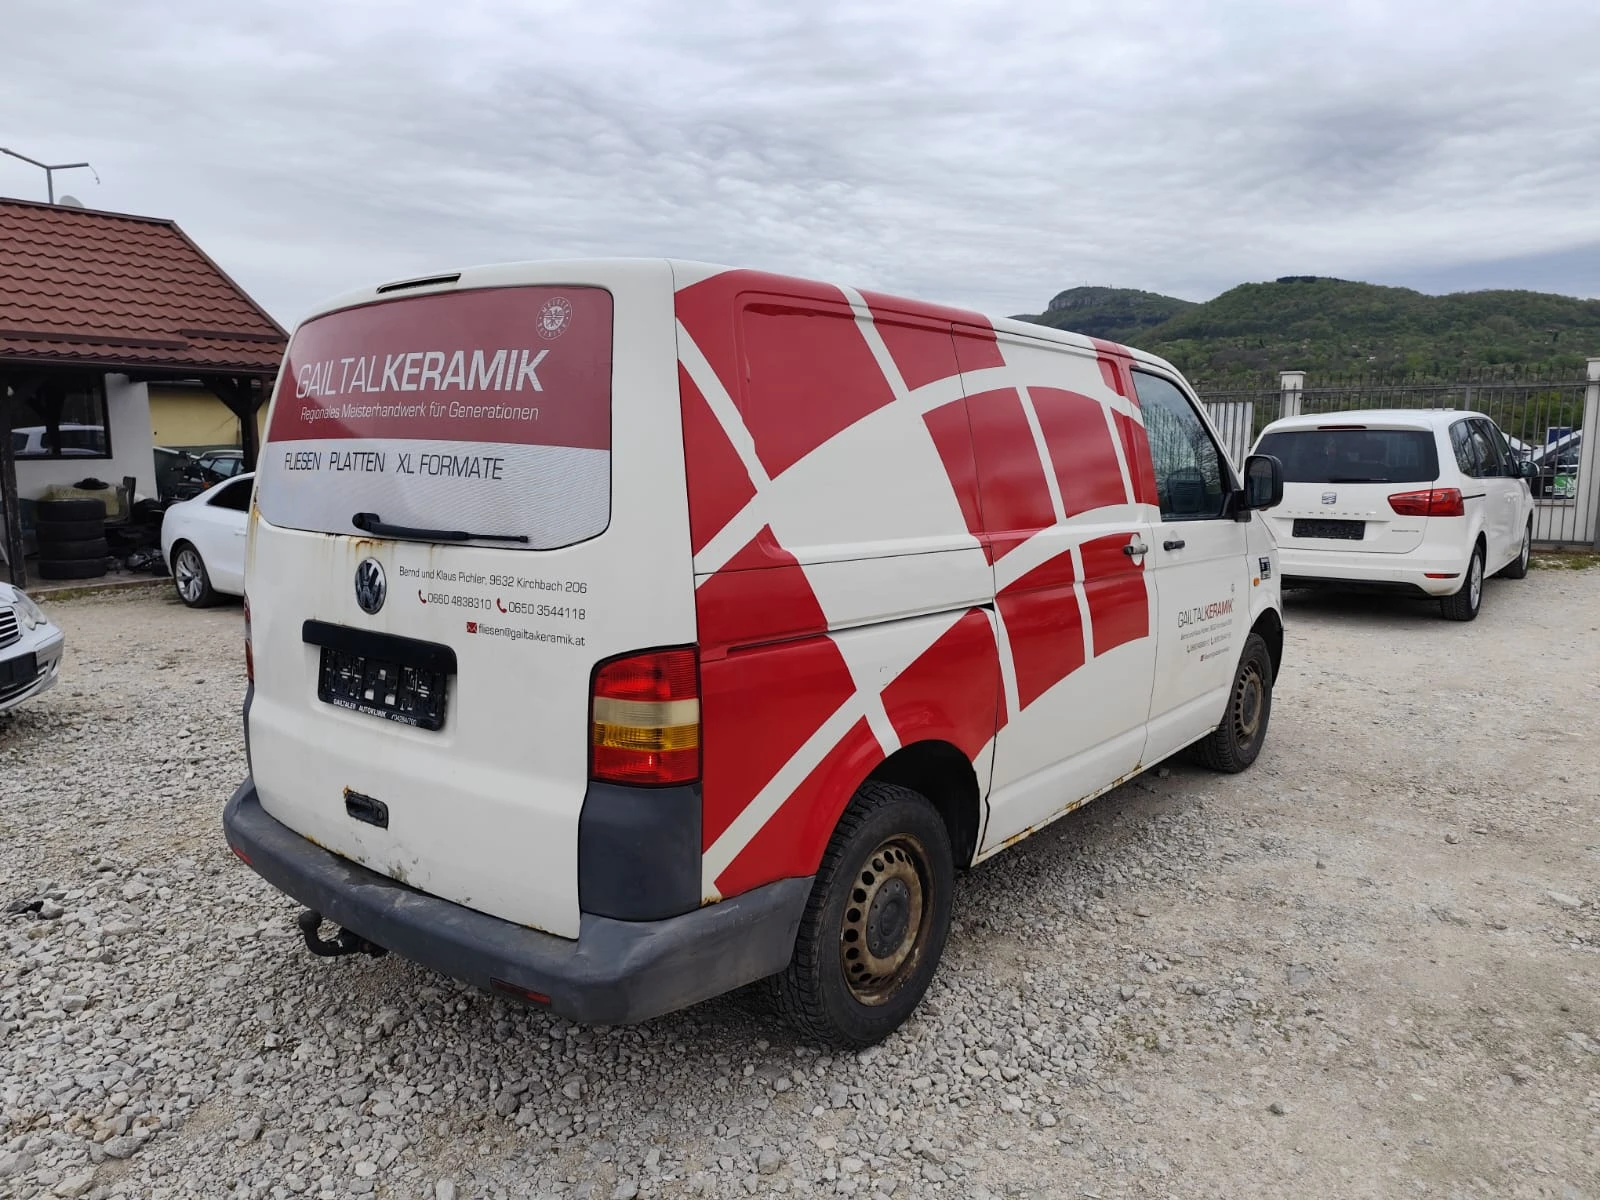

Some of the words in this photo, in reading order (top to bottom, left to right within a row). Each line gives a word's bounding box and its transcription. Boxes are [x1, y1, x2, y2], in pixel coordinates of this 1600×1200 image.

[295, 349, 550, 399] GAILTALKERAMIK
[301, 405, 340, 424] Regionales
[341, 401, 427, 419] Meisterhandwerk
[429, 401, 447, 418] für
[448, 401, 539, 420] Generationen
[285, 452, 321, 471] FLIESEN
[329, 452, 385, 472] PLATTEN
[396, 453, 415, 474] XL
[419, 453, 505, 480] FORMATE
[399, 566, 420, 578] Bernd
[421, 569, 435, 579] und
[436, 569, 457, 582] Klaus
[489, 574, 515, 588] 9632
[516, 576, 563, 592] Kirchbach
[564, 581, 588, 594] 206
[508, 601, 535, 615] 0650
[536, 604, 586, 621] 3544118
